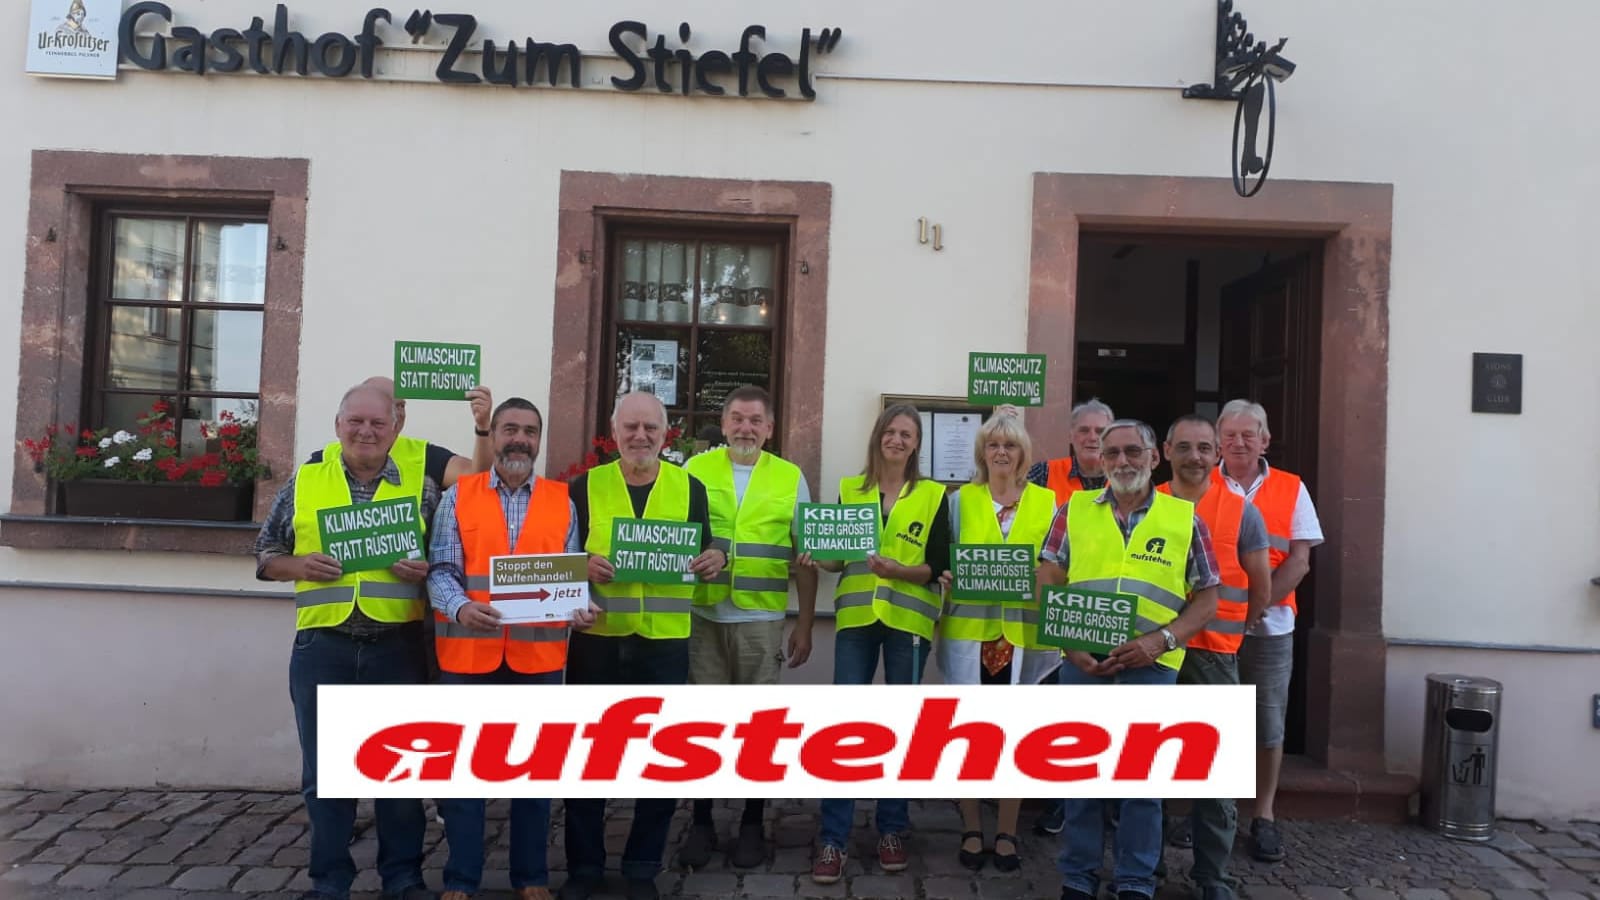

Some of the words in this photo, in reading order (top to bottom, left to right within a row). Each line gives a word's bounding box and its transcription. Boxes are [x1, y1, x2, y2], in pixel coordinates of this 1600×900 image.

[118, 1, 392, 78] Gasthof
[917, 216, 944, 251] 11
[400, 346, 476, 366] KLIMASCHUTZ
[973, 357, 1041, 375] KLIMASCHUTZ
[400, 371, 429, 388] STATT
[431, 368, 475, 390] RÜSTUNG
[973, 379, 998, 395] STATT
[1000, 376, 1040, 397] RÜSTUNG
[324, 502, 414, 534] KLIMASCHUTZ
[803, 507, 874, 520] KRIEG
[617, 523, 697, 546] KLIMASCHUTZ
[804, 523, 817, 535] IST
[818, 523, 835, 535] DER
[836, 520, 874, 536] GRÖSSTE
[329, 538, 363, 561] STATT
[365, 530, 418, 557] RÜSTUNG
[803, 537, 874, 550] KLIMAKILLER
[615, 549, 647, 570] STATT
[955, 548, 1030, 562] KRIEG
[1130, 553, 1172, 568] aufstehen
[496, 561, 532, 571] Stoppt
[533, 561, 553, 570] den
[956, 563, 970, 576] IST
[971, 564, 989, 576] DER
[990, 560, 1030, 577] GRÖSSTE
[496, 571, 573, 583] Waffenhandel!
[957, 578, 1030, 592] KLIMAKILLER
[552, 587, 582, 602] jetzt
[1047, 590, 1132, 615] KRIEG
[1046, 606, 1061, 621] IST
[1063, 609, 1082, 625] DER
[1084, 611, 1130, 631] GRÖSSTE
[1044, 622, 1128, 647] KLIMAKILLER
